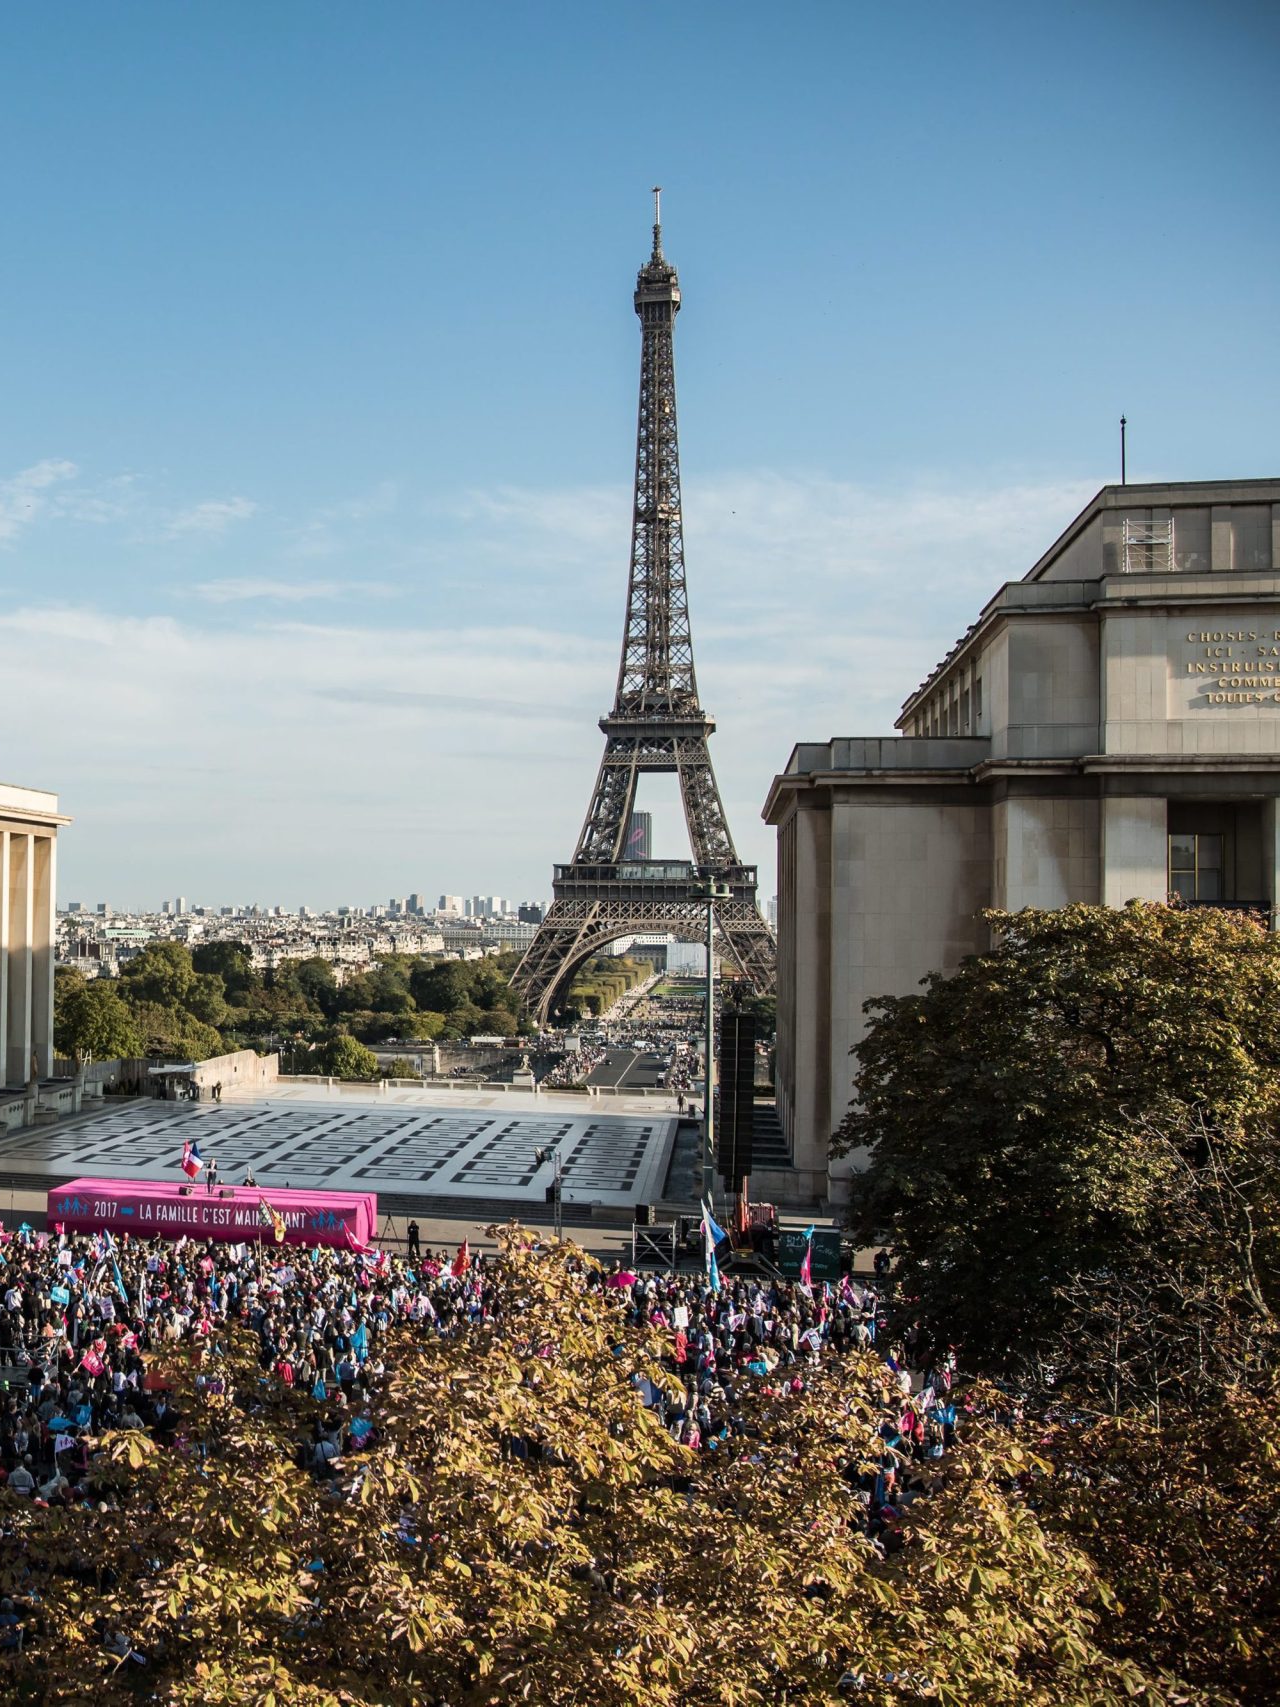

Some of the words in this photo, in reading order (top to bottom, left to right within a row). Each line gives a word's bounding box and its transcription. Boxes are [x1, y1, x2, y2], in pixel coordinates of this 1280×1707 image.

[1188, 632, 1256, 642] CHOSES
[1207, 647, 1232, 657] ICI
[1187, 662, 1280, 673] INSTRUIS
[1207, 692, 1263, 703] TOUTES
[94, 1201, 117, 1218] 2017
[140, 1204, 152, 1220] LA
[156, 1205, 198, 1223] FAMILLE
[203, 1207, 231, 1225] C'EST
[235, 1209, 307, 1229] MAINANT
